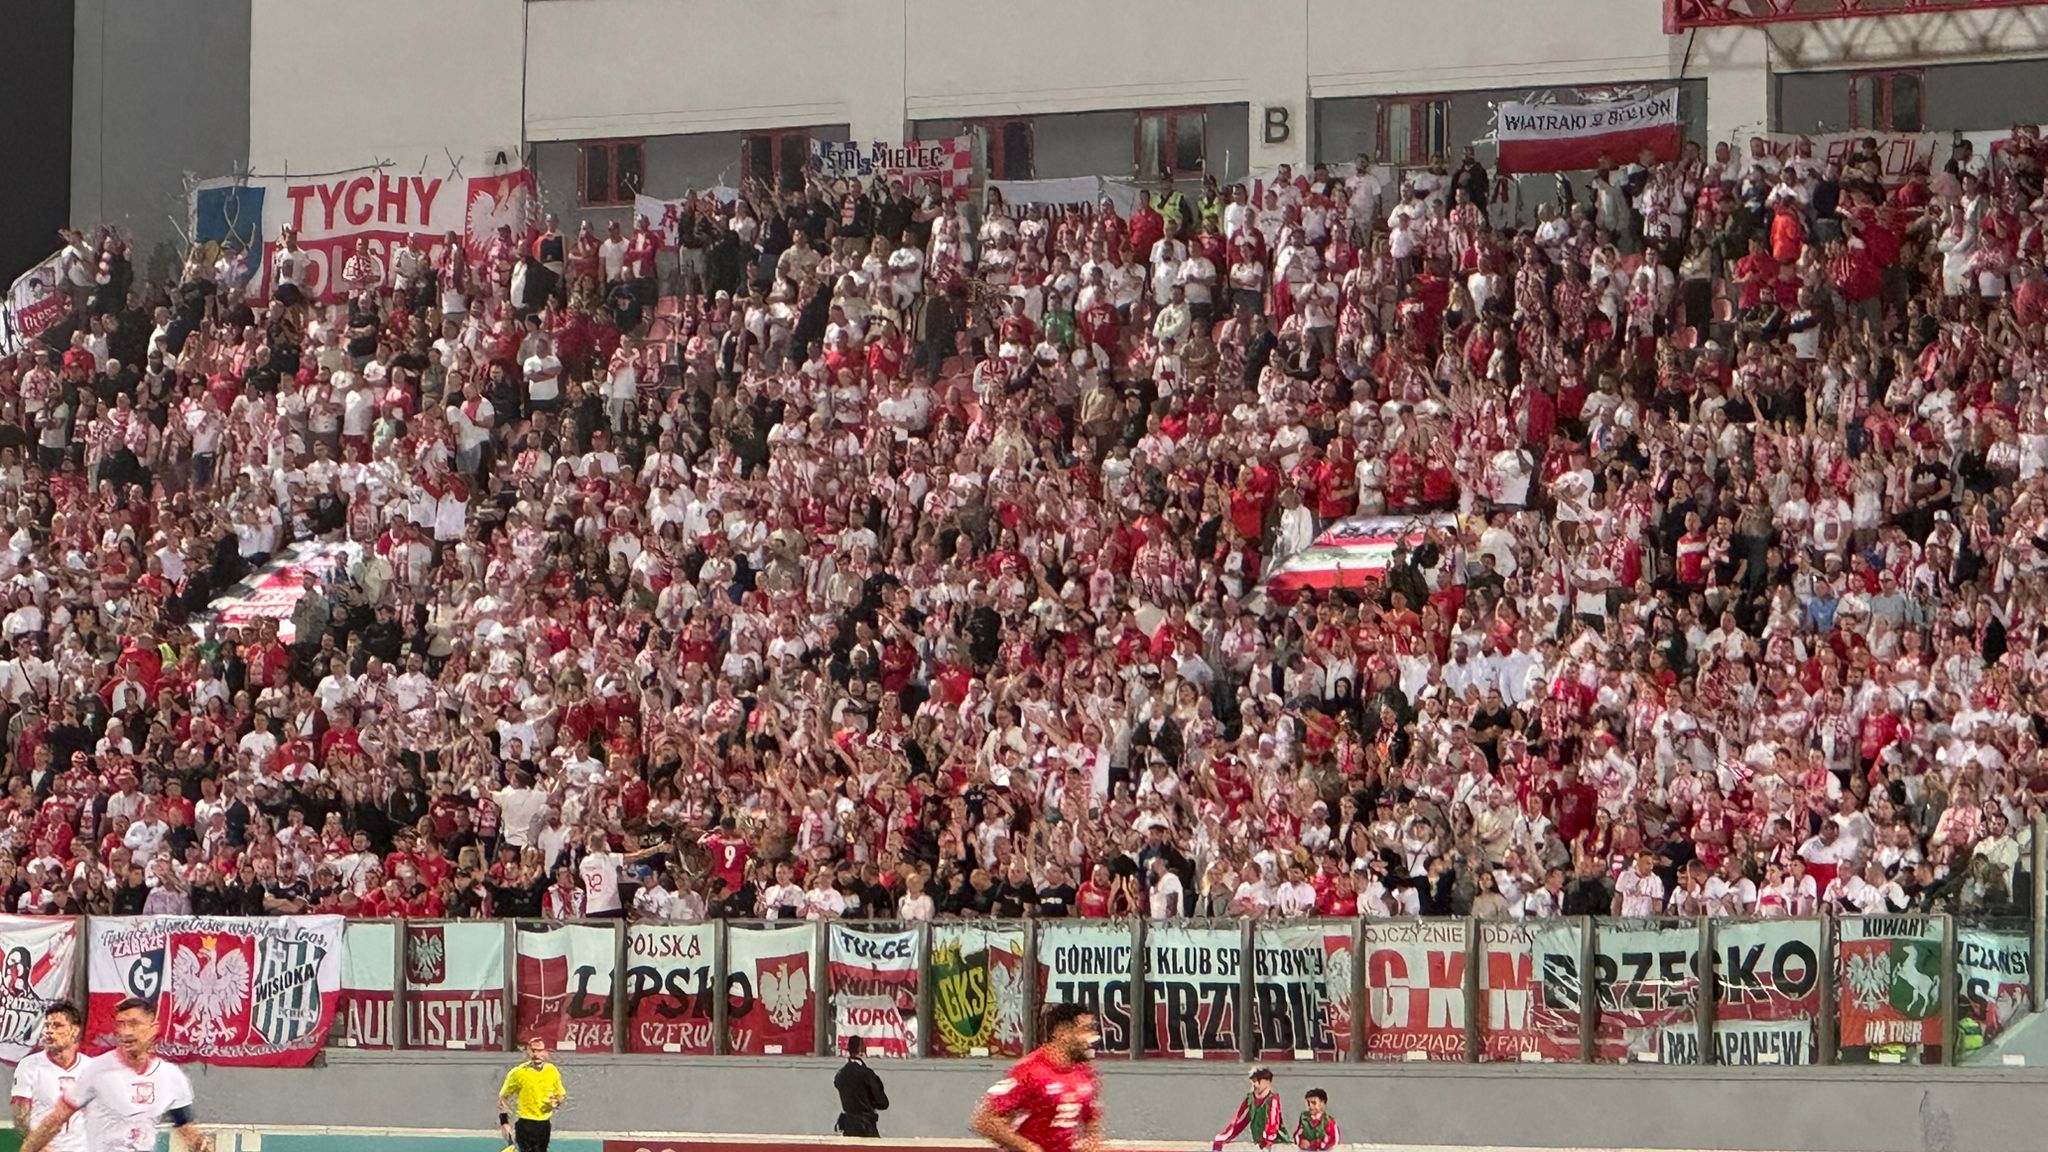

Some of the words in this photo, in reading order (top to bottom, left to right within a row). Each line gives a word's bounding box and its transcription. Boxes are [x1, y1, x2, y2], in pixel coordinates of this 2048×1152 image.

[1265, 107, 1290, 143] B
[287, 174, 442, 234] TYCHY
[724, 845, 736, 869] 9
[112, 934, 165, 957] ZABRZE
[841, 930, 912, 960] TULCE
[1157, 946, 1212, 975] KLUB
[1217, 947, 1324, 976] SPRTOWY
[939, 966, 985, 1023] GKS
[1368, 948, 1533, 1031] GKM
[1497, 1035, 1539, 1053] FANI
[1667, 1031, 1802, 1067] MAAPANEW
